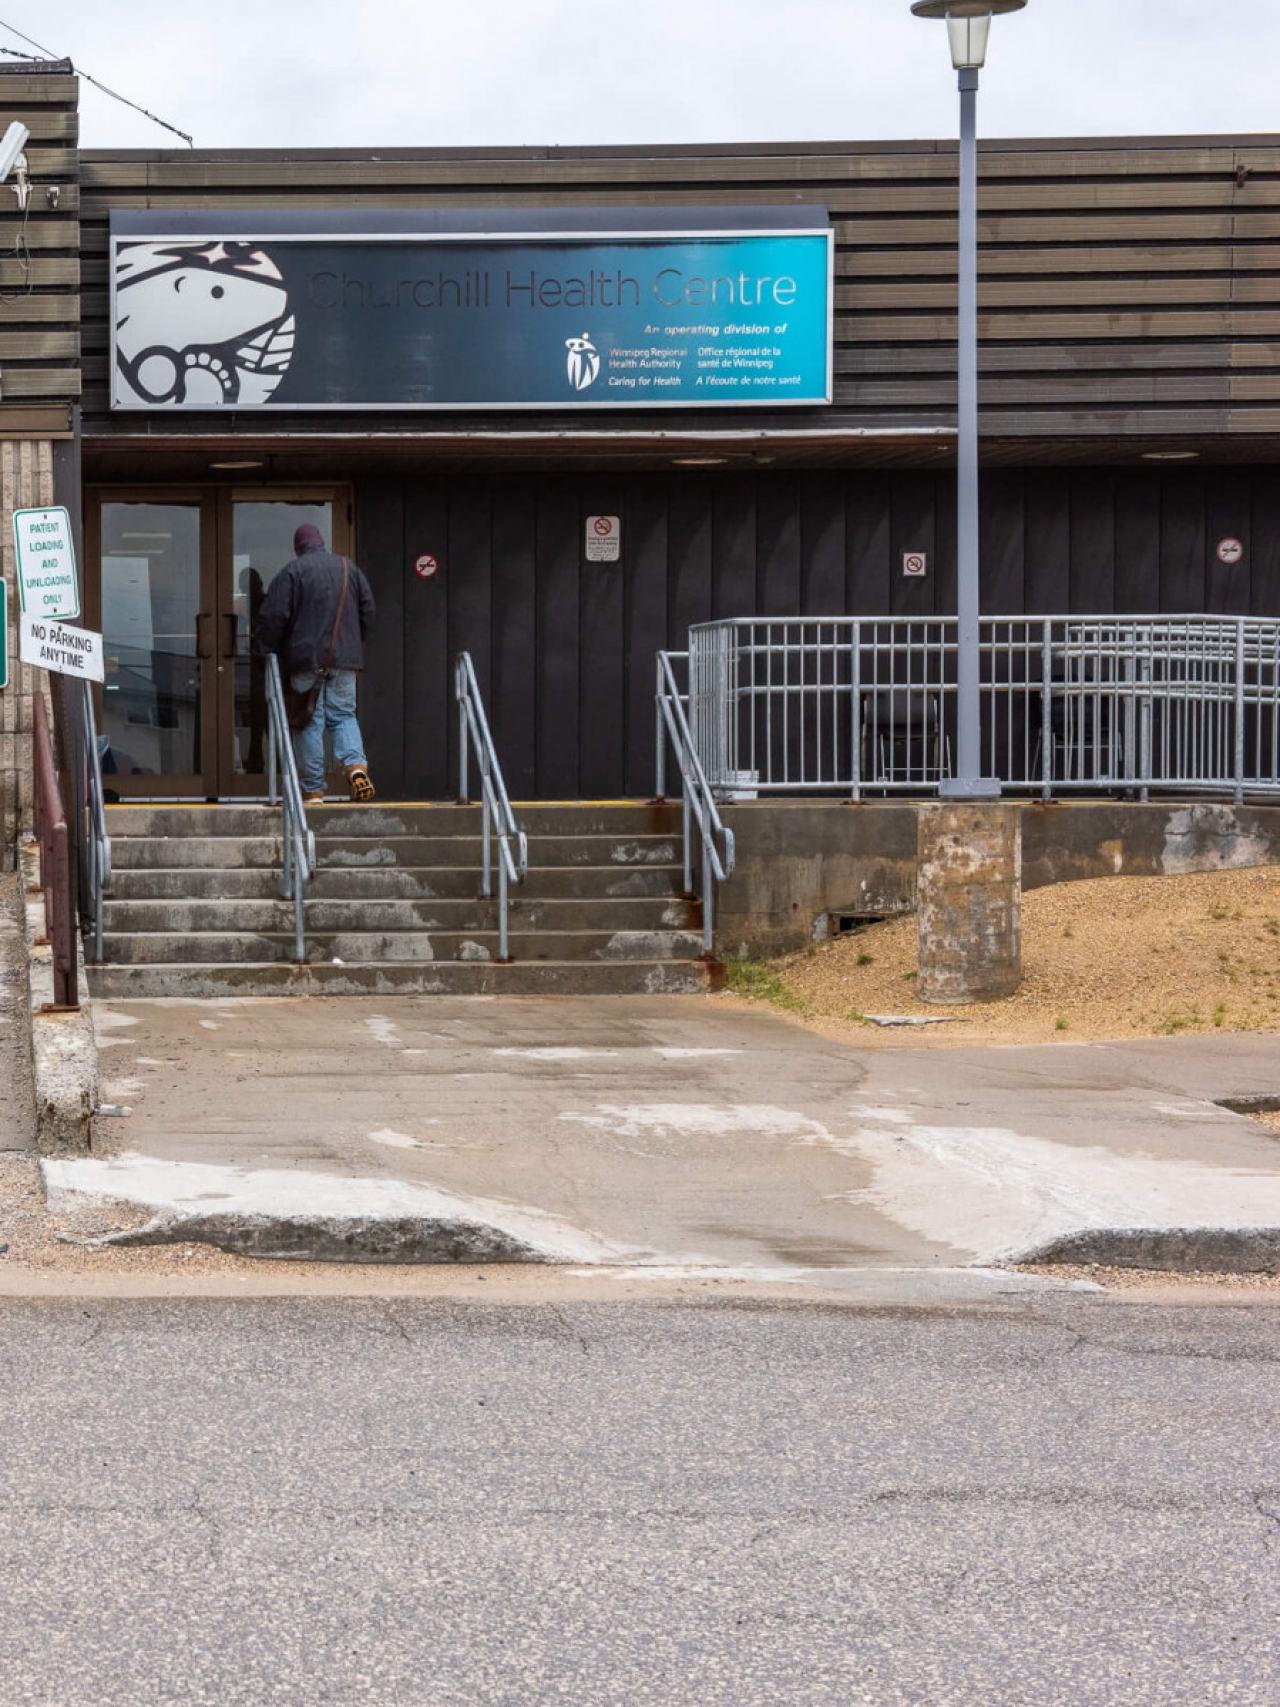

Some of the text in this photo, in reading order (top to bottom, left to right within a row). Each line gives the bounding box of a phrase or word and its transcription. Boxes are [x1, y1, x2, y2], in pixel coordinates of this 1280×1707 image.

[309, 268, 797, 308] Churchill Health Centre
[644, 322, 788, 337] An operating division of
[610, 347, 688, 359] Winnipeg Regional
[697, 346, 782, 359] Office régional de la
[609, 359, 681, 370] Health Authority
[697, 358, 774, 370] santé de Winnipeg
[608, 375, 682, 389] Caring for Health
[740, 375, 751, 386] de
[753, 376, 776, 386] notre
[778, 374, 802, 386] santé
[29, 522, 59, 534] PATIENT
[29, 540, 64, 552] LOADING
[42, 558, 58, 569] AND
[26, 575, 72, 589] UNLOADING
[42, 594, 62, 605] ONLY
[31, 623, 93, 653] NO PARKING
[39, 644, 85, 670] ANYTIME
